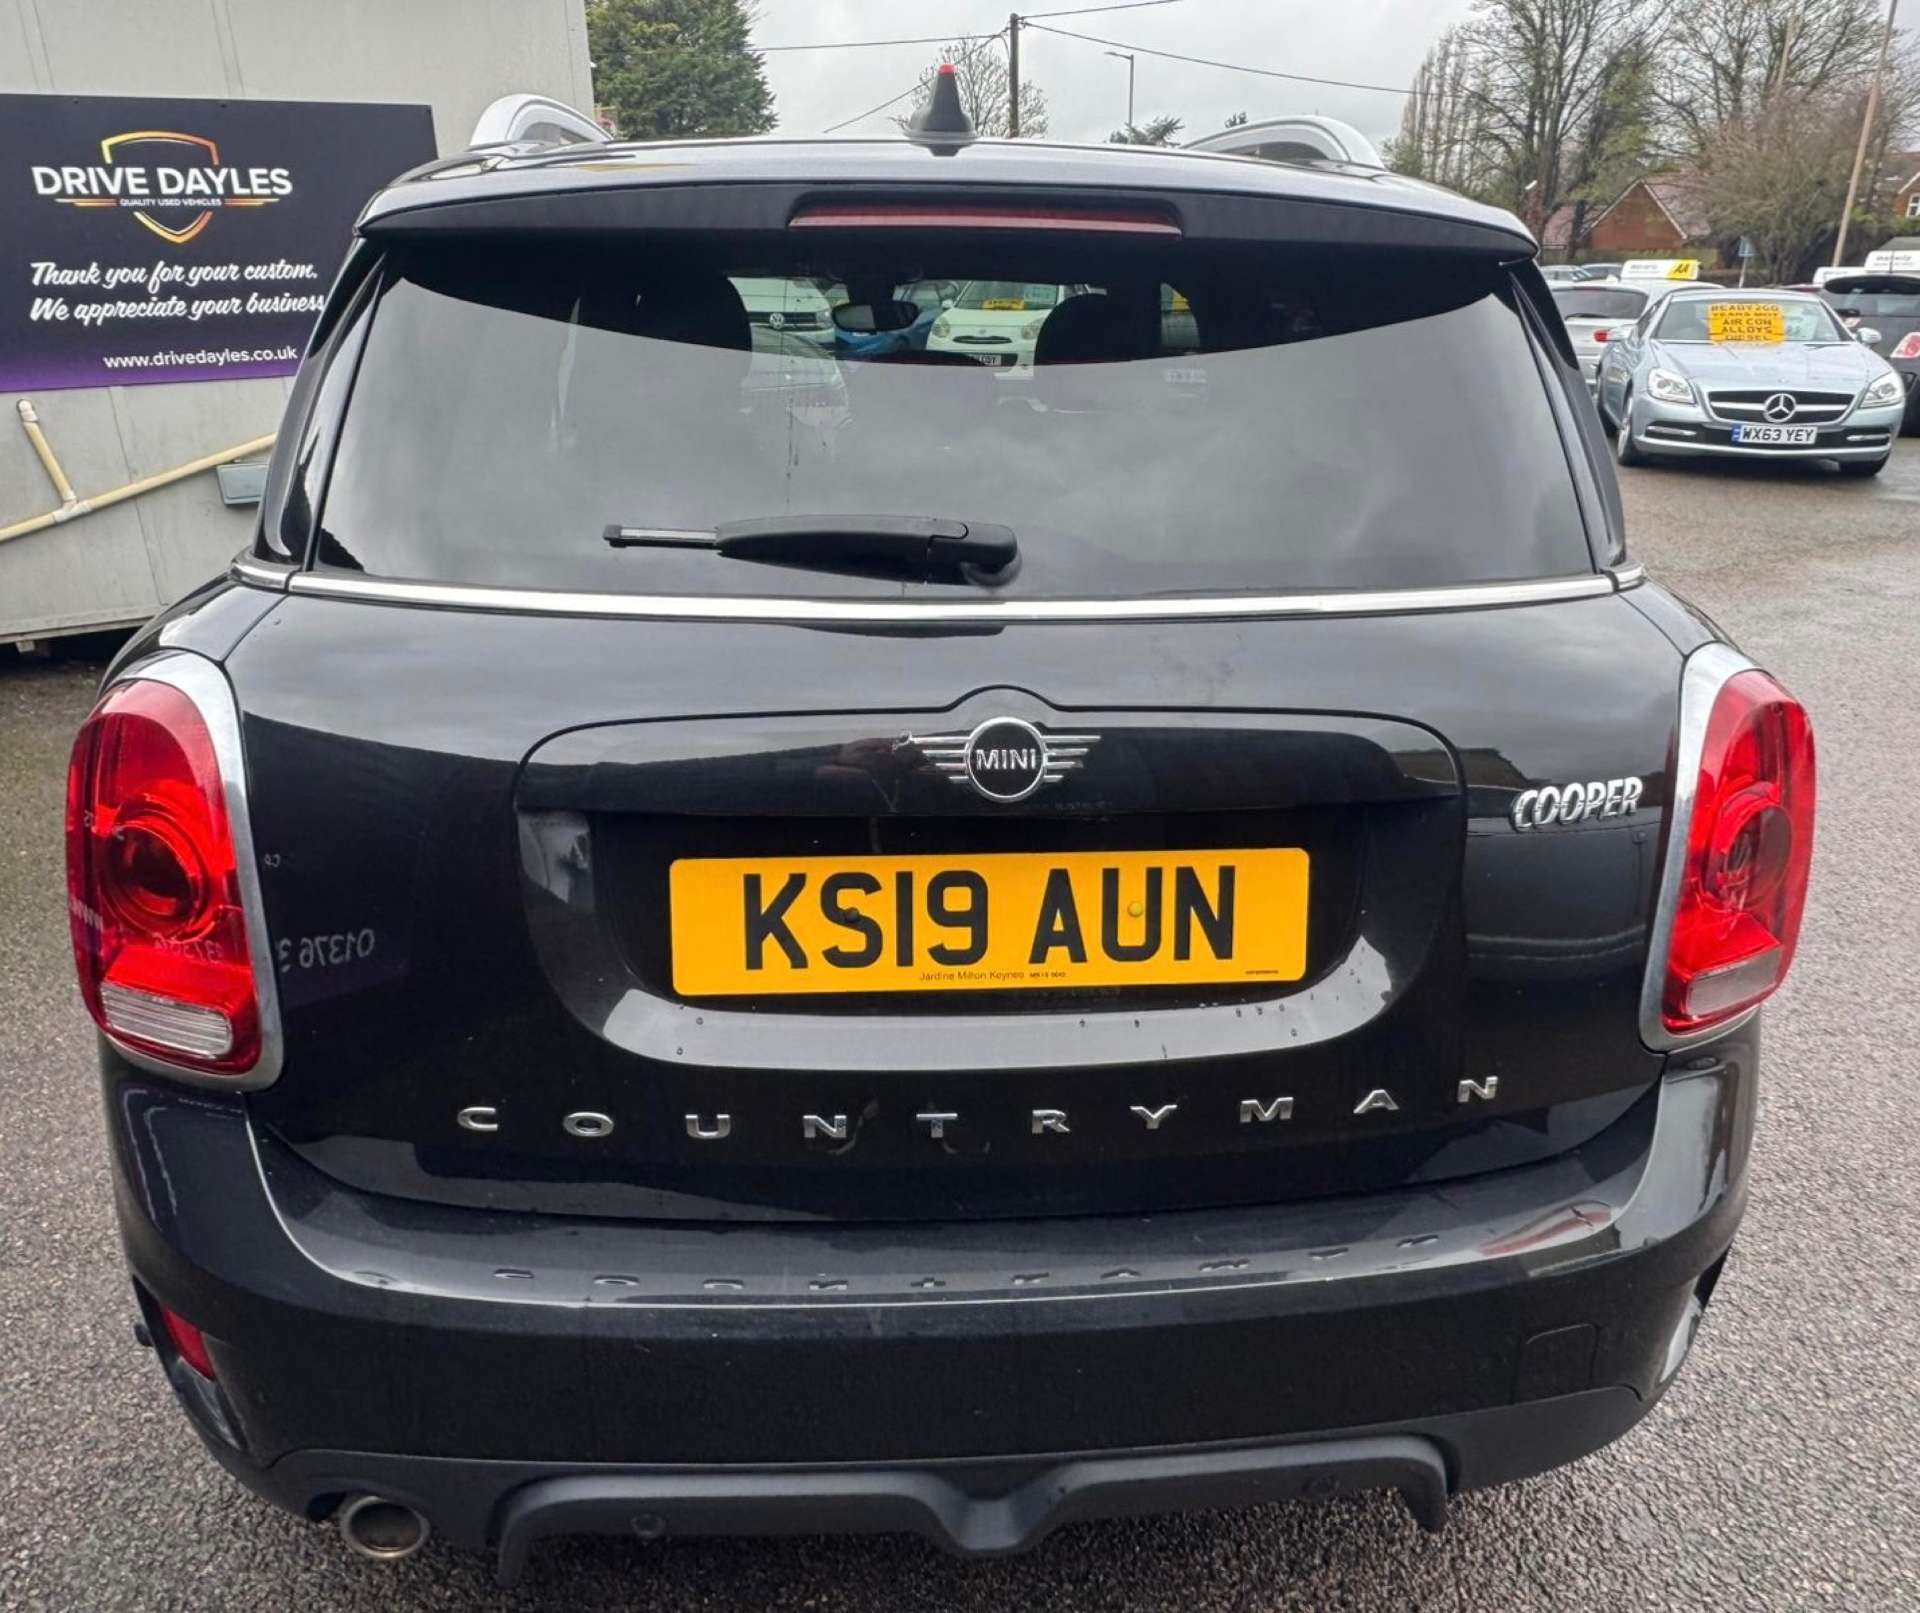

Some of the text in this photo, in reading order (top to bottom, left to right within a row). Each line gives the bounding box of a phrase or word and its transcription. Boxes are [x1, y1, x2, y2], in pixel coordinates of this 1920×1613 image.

[31, 166, 293, 195] DRIVE DAYLES
[120, 199, 156, 207] QUALITY
[30, 258, 318, 294] Thank you for your custom.
[30, 292, 325, 326] We appreciate your business
[1723, 318, 1743, 326] AIR
[103, 345, 298, 369] www.drivedayles.co.uk
[1742, 427, 1815, 442] WX63 YEY
[976, 748, 1036, 771] MINI
[1511, 776, 1643, 832] COOPER
[743, 865, 1235, 969] KS19 AUN
[920, 971, 955, 981] Jardine
[458, 1076, 1498, 1139] COUNTRYMAN
